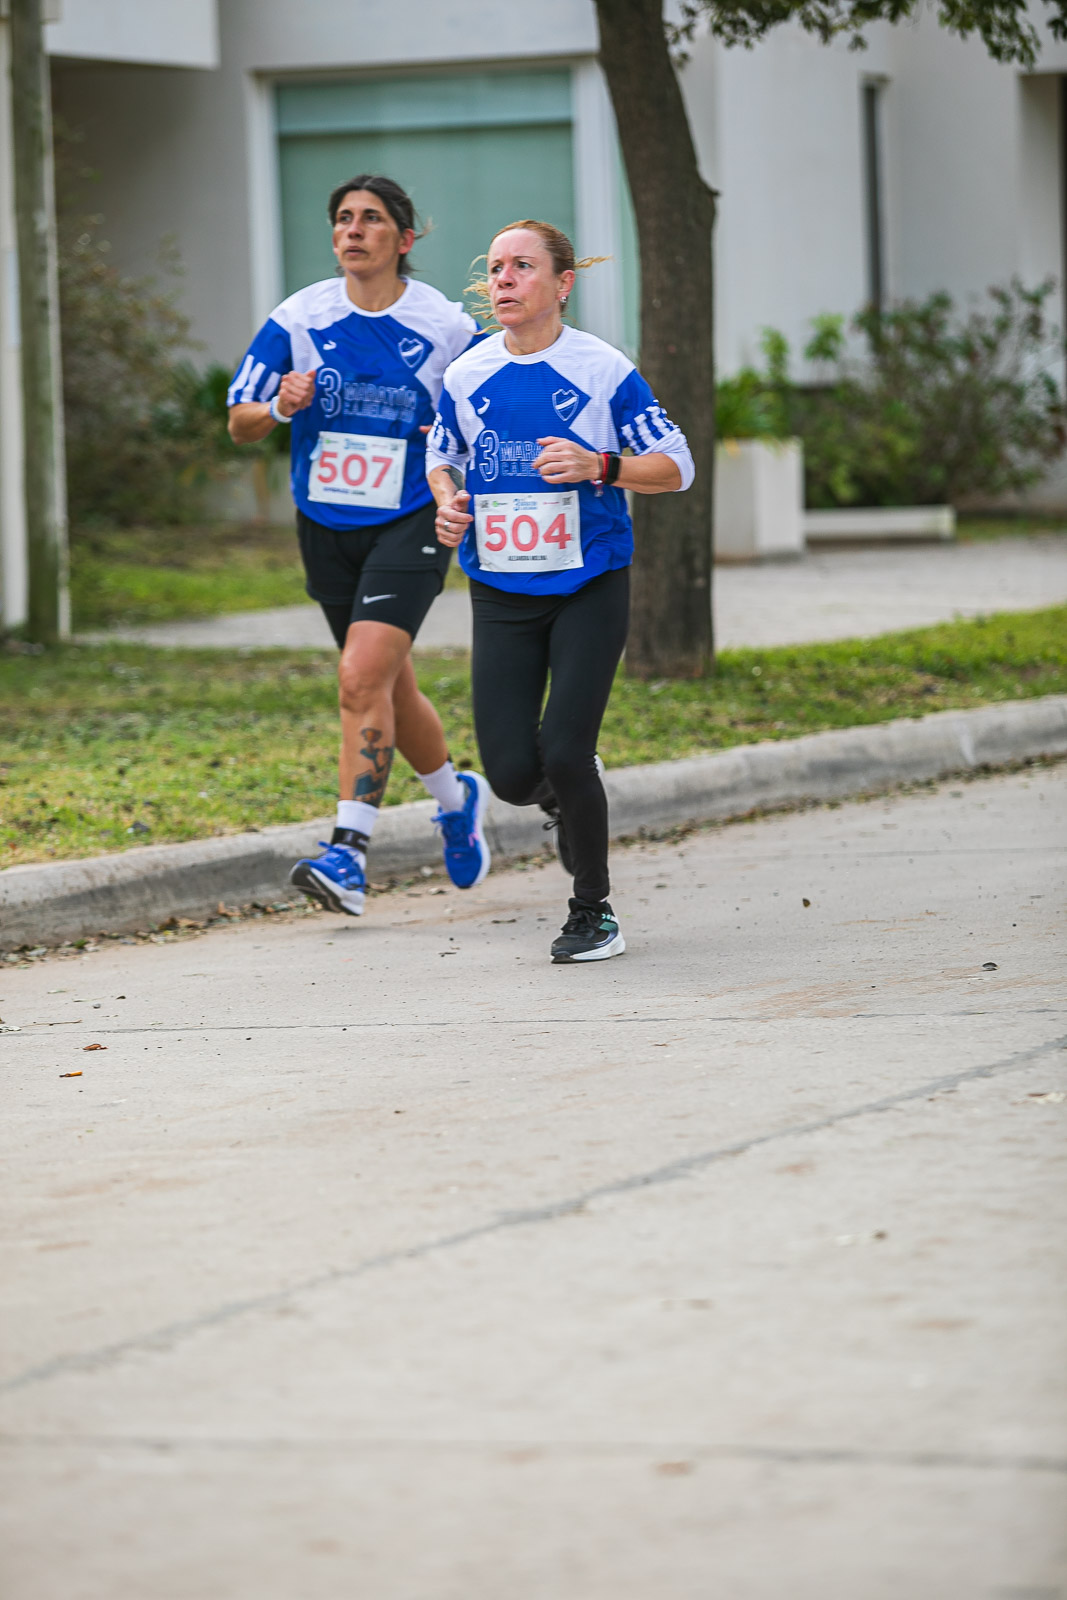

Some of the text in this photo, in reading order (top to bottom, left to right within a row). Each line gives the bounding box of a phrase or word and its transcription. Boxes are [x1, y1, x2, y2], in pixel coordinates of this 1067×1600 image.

[317, 367, 417, 418] 3 MARATÓN
[316, 451, 394, 488] 507
[478, 429, 543, 482] 3 MARA
[484, 513, 572, 552] 504
